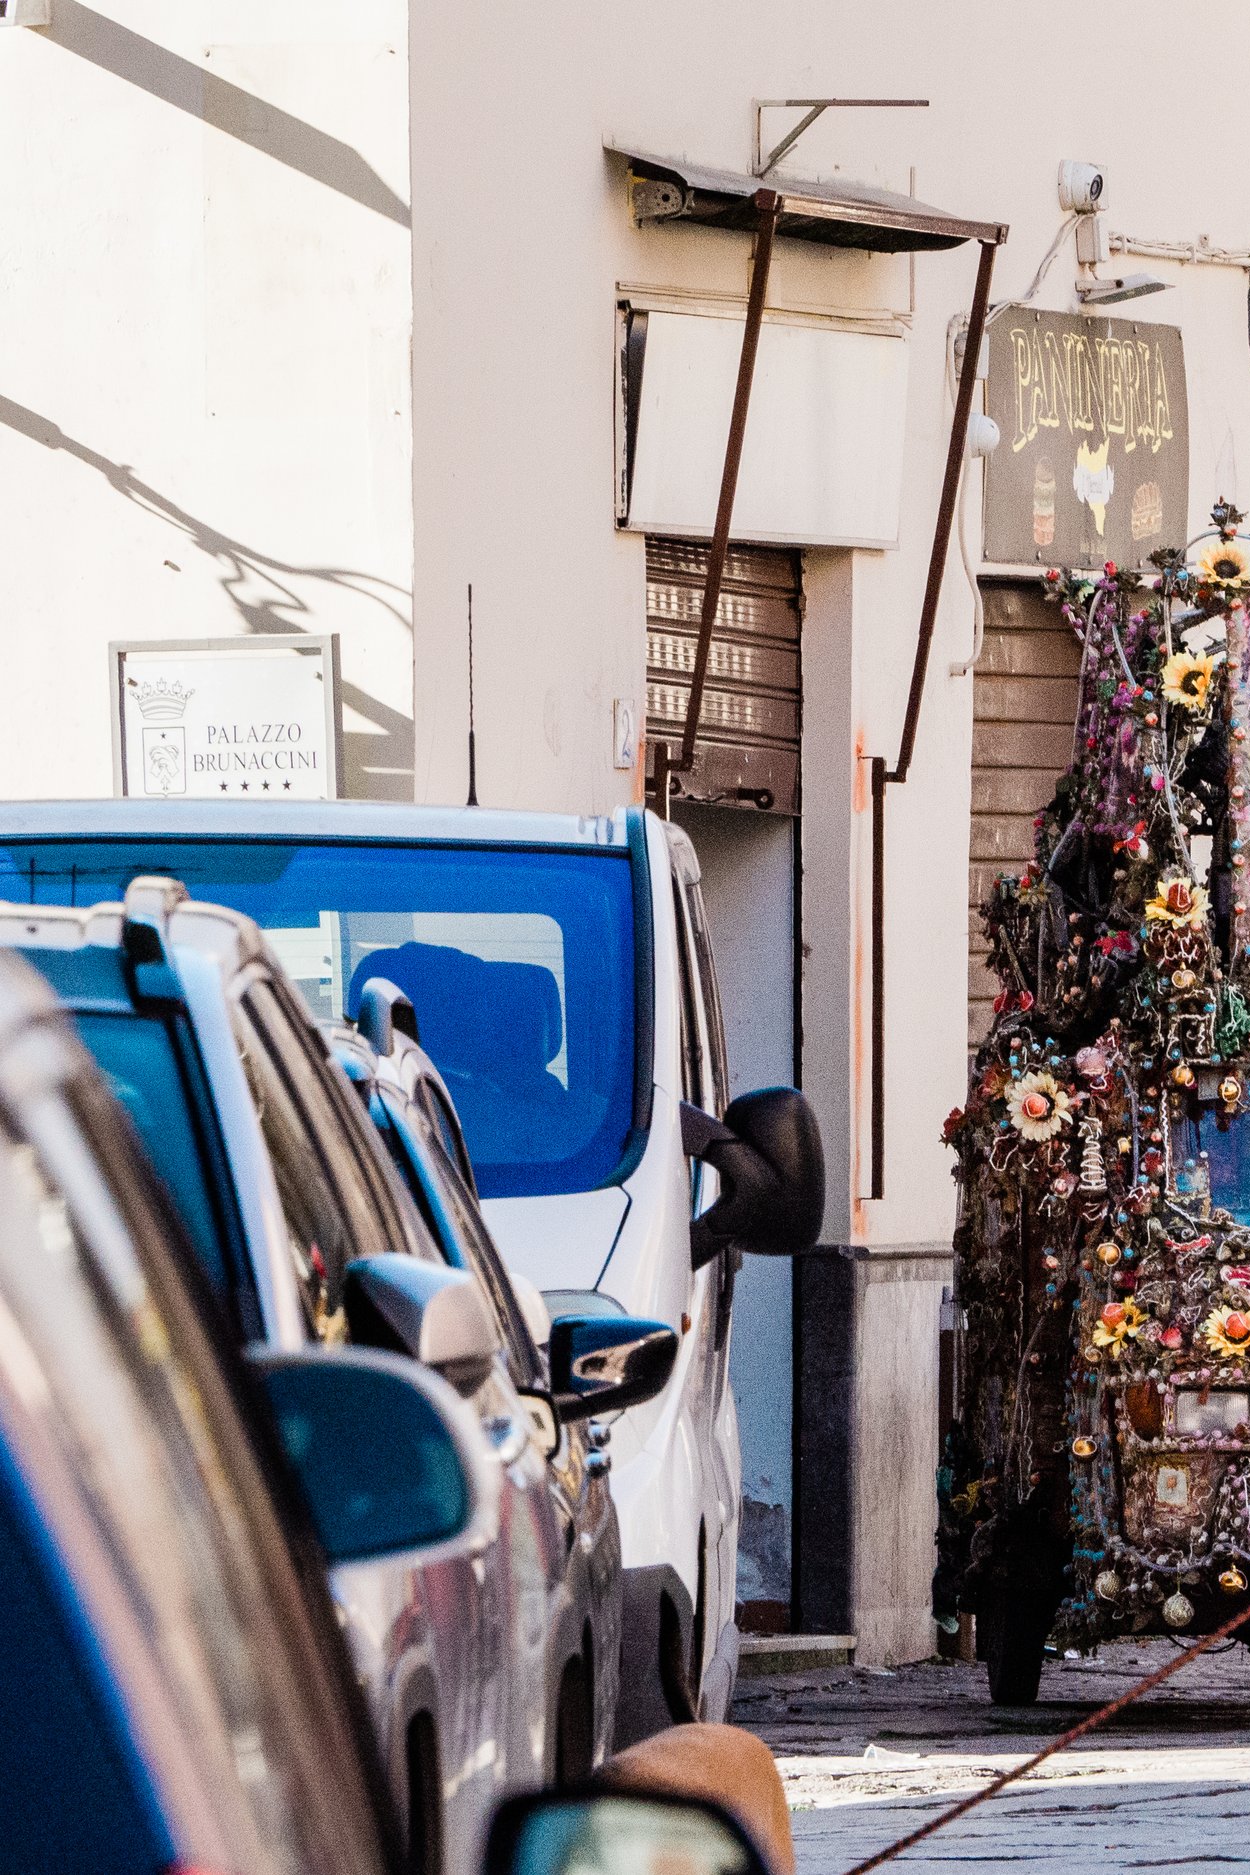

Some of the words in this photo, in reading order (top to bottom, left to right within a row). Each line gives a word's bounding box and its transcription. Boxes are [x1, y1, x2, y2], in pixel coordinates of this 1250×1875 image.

[1010, 327, 1173, 453] PANINERIA
[207, 722, 301, 745] PALAZZO
[193, 750, 318, 773] BRUNACCINI
